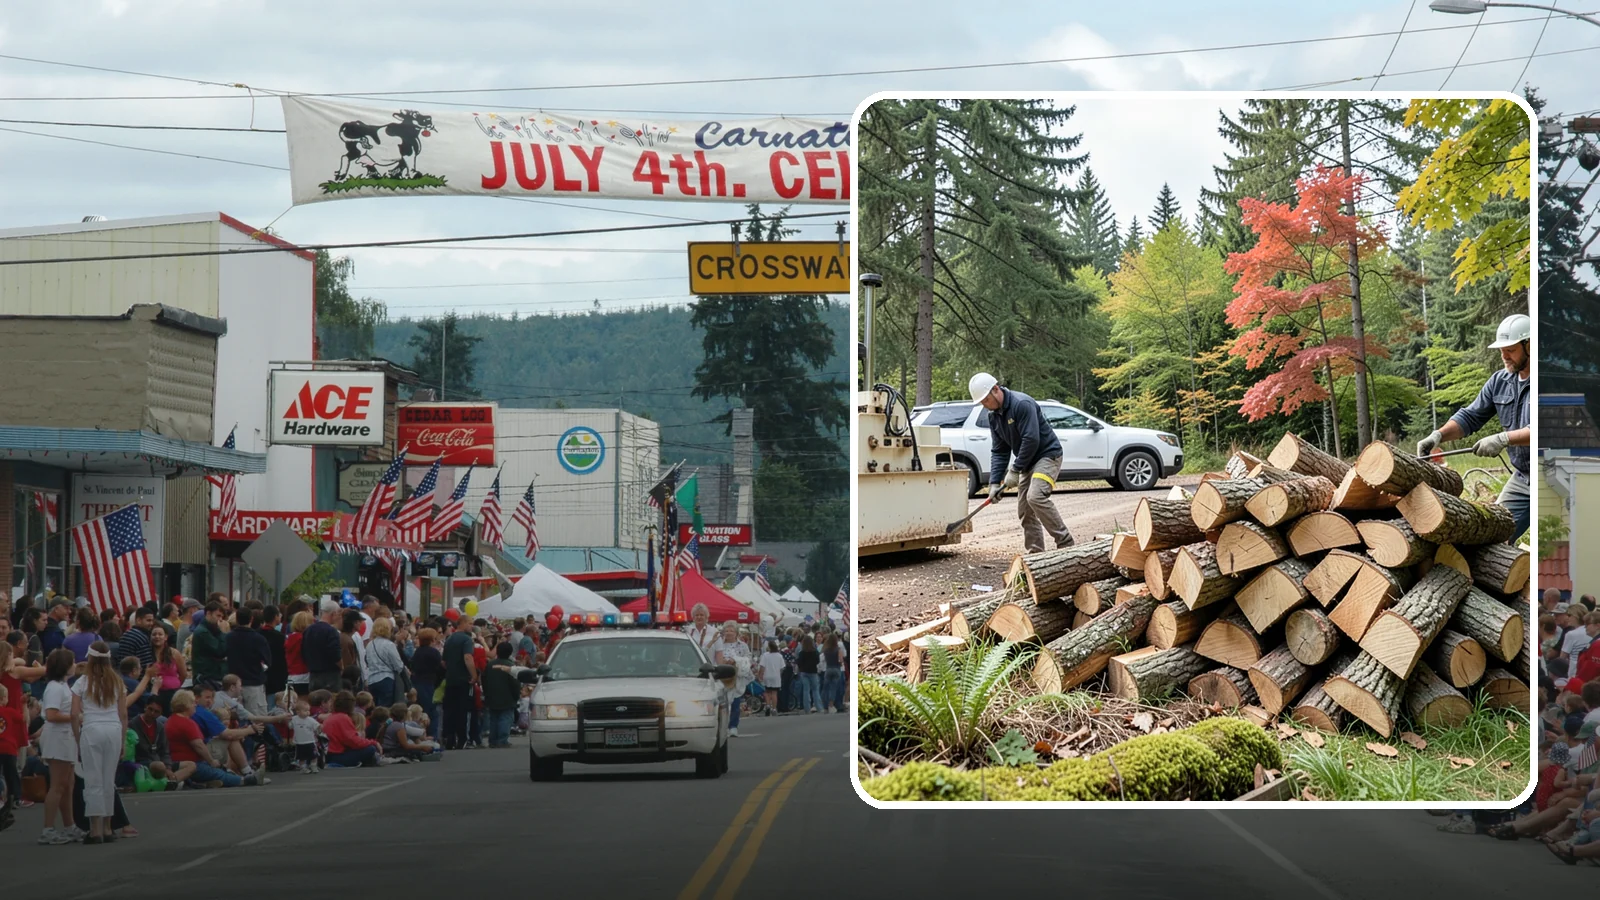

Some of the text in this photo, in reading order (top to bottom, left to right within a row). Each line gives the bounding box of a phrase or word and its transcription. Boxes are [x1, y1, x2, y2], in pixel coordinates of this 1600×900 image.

[481, 141, 604, 192] JULY
[632, 150, 746, 198] 4th.
[697, 254, 850, 280] CROSSWA
[283, 380, 373, 420] ACE
[405, 409, 486, 422] CEDAR LOG
[283, 420, 371, 437] Hardware
[416, 428, 476, 447] Coca-Cola
[354, 467, 385, 481] Simpl
[95, 485, 124, 495] Vincent
[126, 486, 136, 495] de
[137, 486, 155, 495] Paul
[687, 526, 741, 535] CRNATION
[699, 535, 730, 543] GLASS
